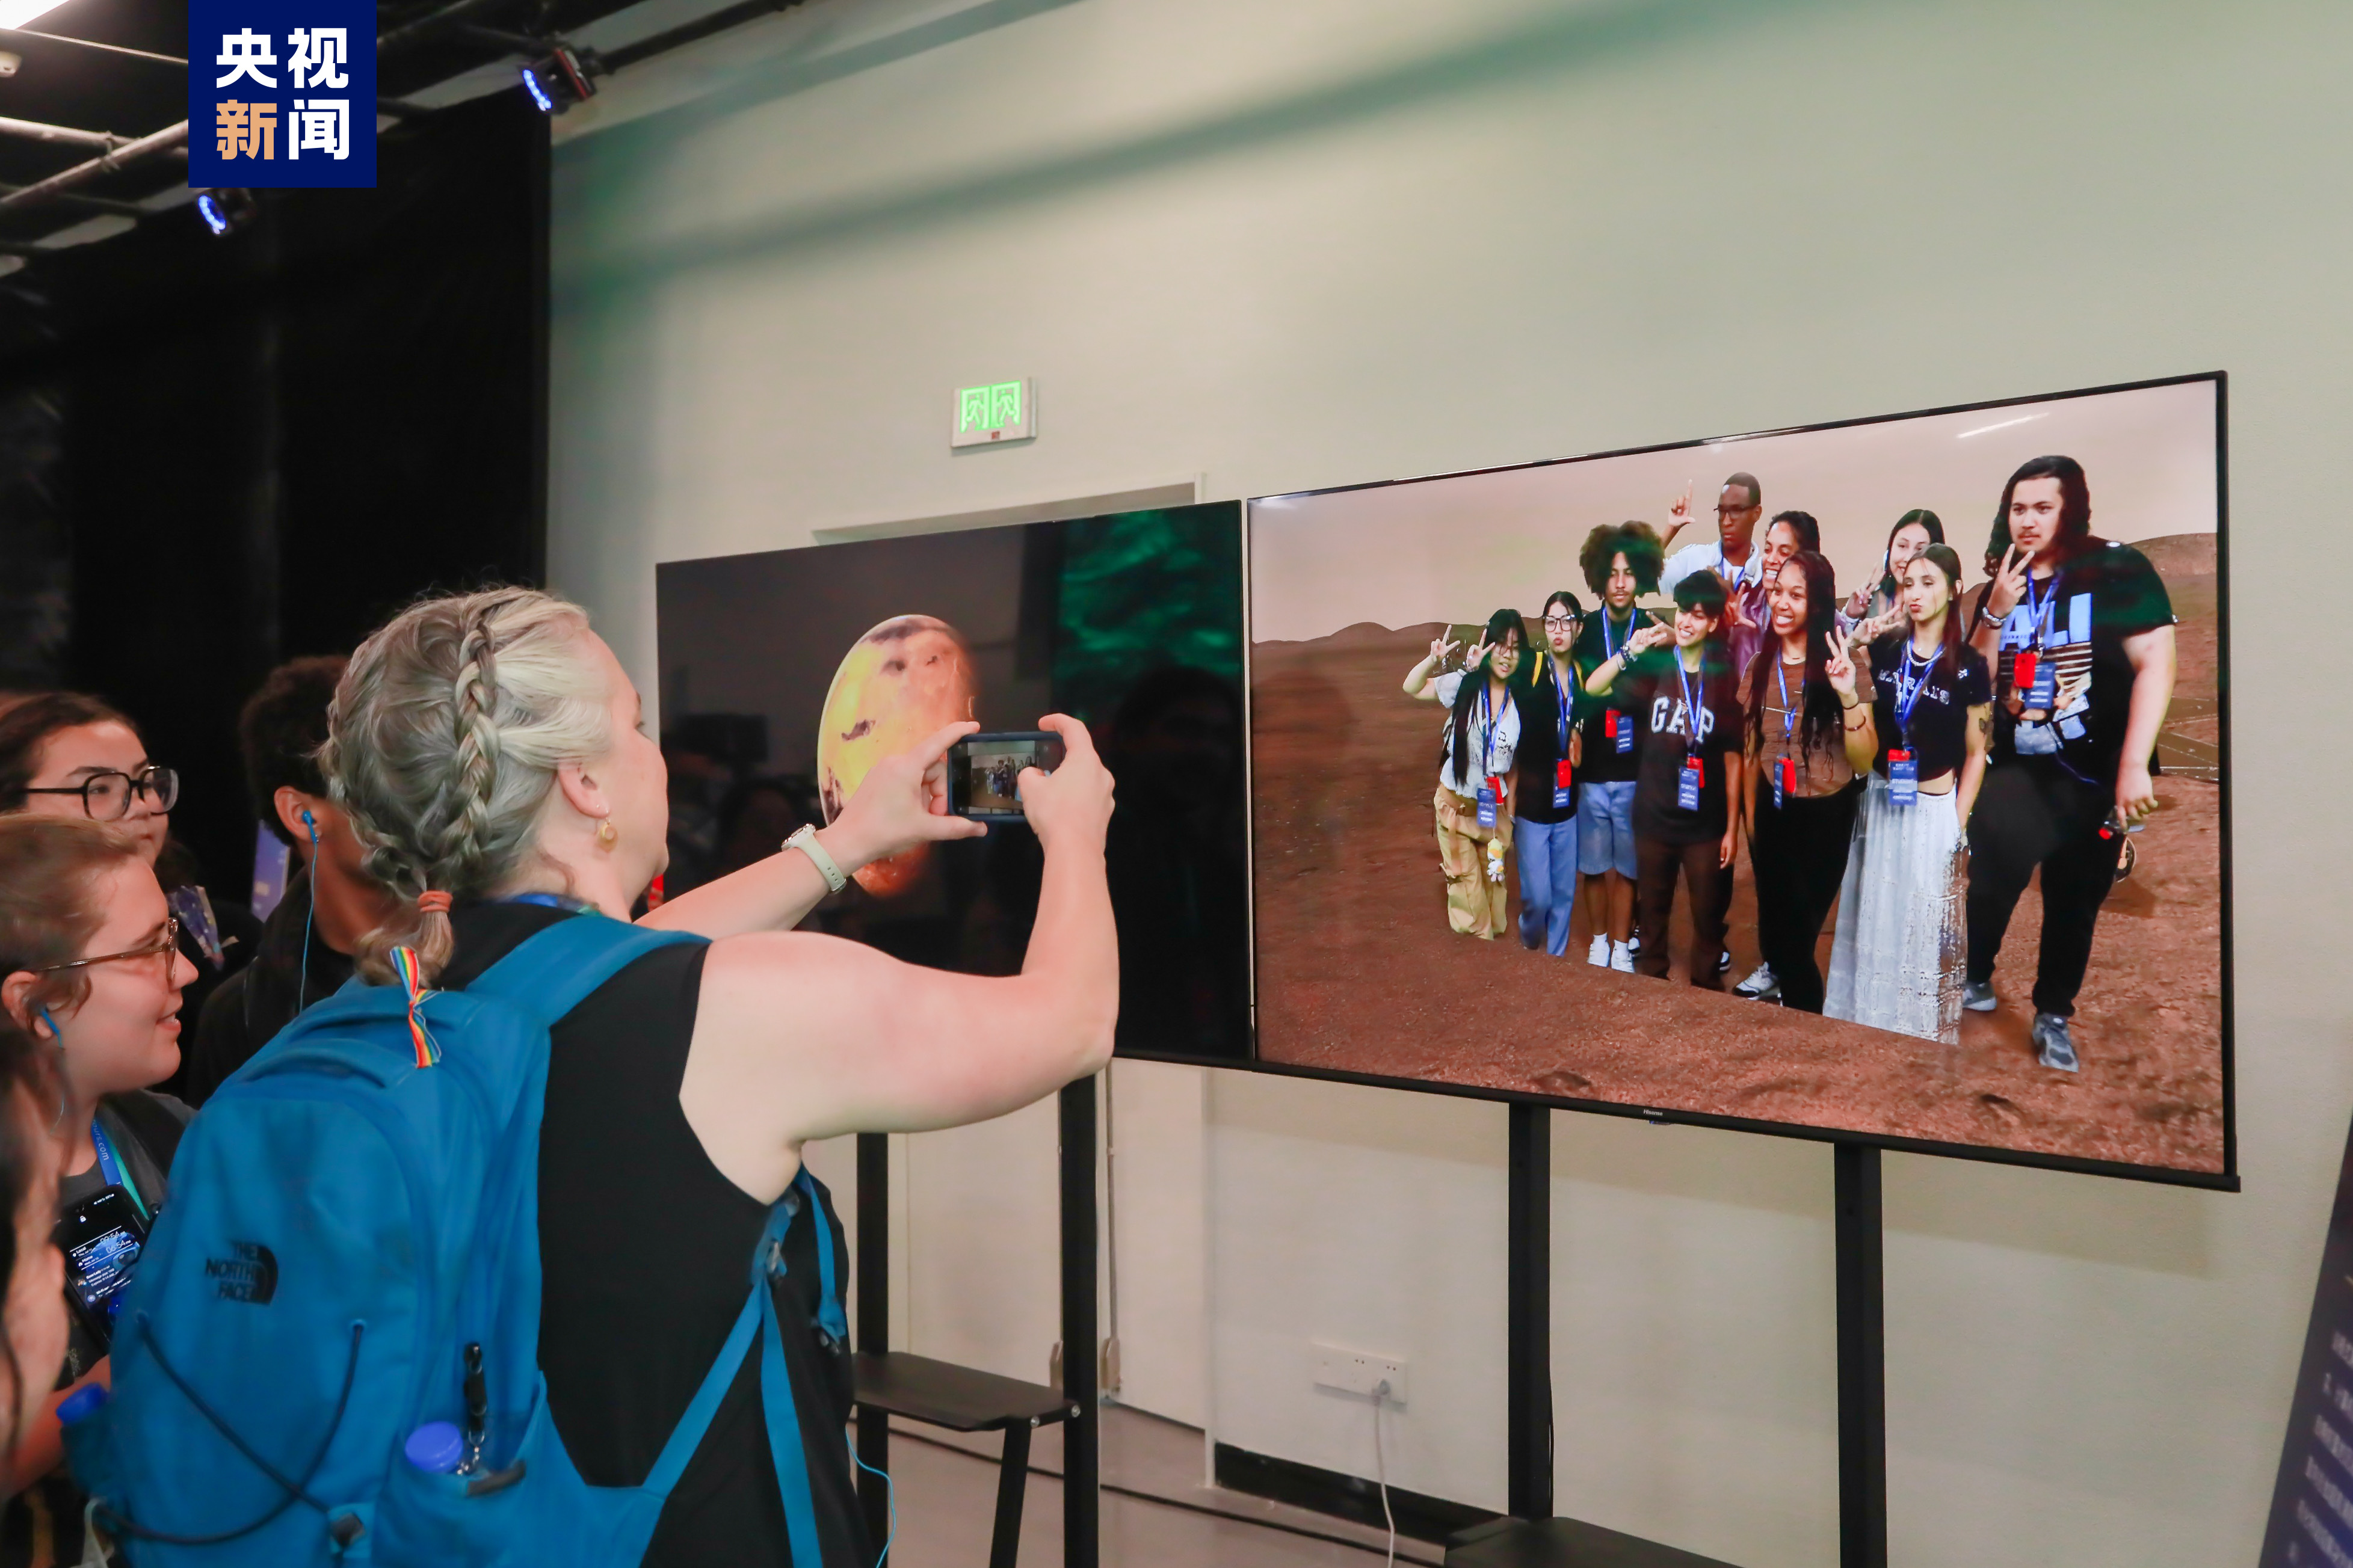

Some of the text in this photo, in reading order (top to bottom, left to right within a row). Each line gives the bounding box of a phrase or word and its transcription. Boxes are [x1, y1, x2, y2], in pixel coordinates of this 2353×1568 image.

[1651, 696, 1714, 745] GAP
[232, 1242, 258, 1261] THE
[205, 1257, 256, 1282] NORTH
[218, 1282, 254, 1302] FACE
